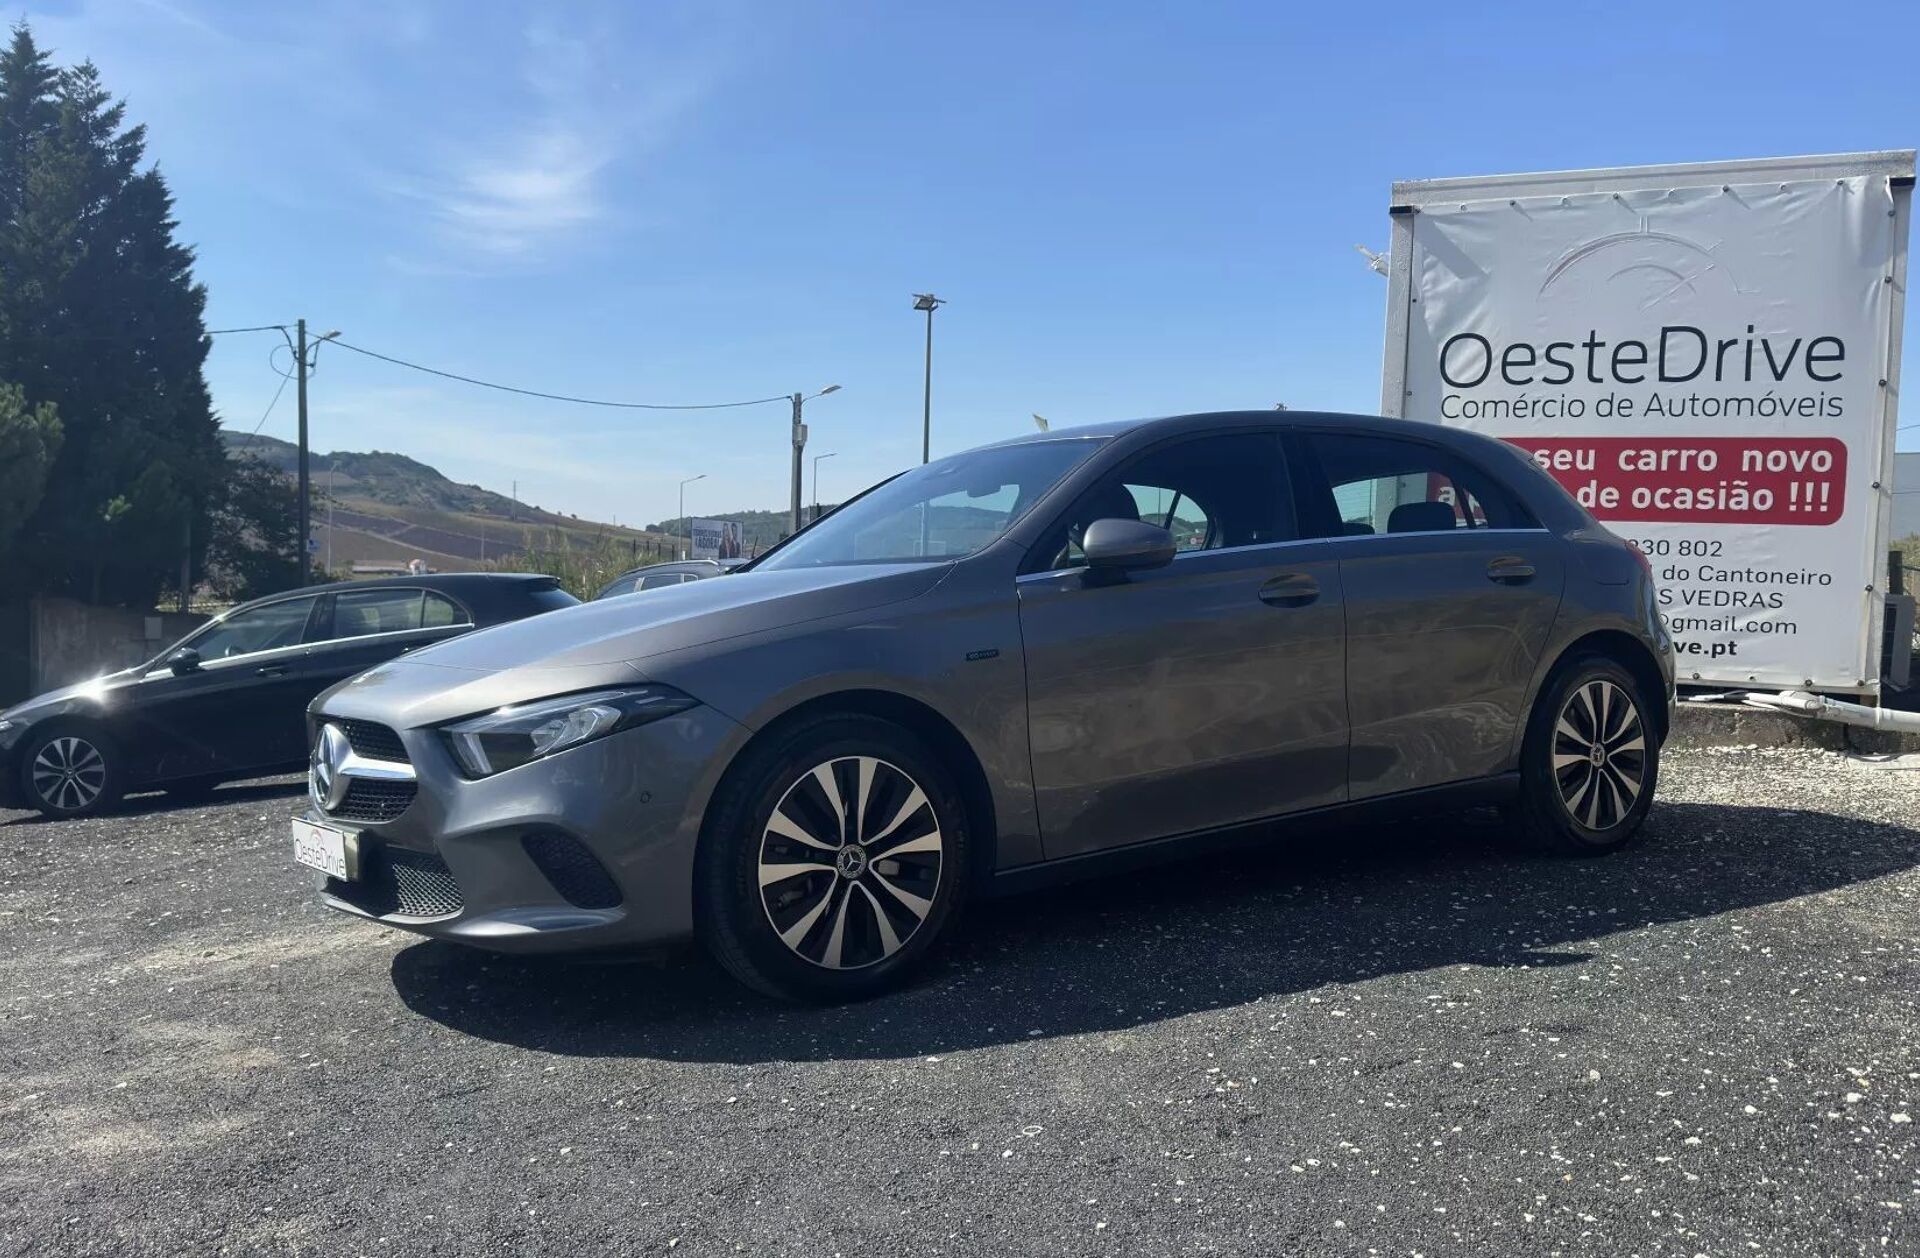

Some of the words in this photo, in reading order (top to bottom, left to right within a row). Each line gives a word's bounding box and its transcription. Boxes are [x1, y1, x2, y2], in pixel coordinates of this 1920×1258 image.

[1440, 324, 1845, 388] OesteDrive
[1441, 393, 1585, 418] Comércio
[1595, 392, 1633, 418] de
[1644, 390, 1843, 417] Automóveis
[1533, 448, 1596, 471] seu
[1618, 449, 1718, 472] carro
[1742, 449, 1833, 473] novo
[1576, 479, 1620, 509] de
[1631, 480, 1774, 511] ocasião
[1788, 481, 1830, 512] !!!
[1678, 540, 1722, 557] 802
[1662, 564, 1690, 581] do
[1698, 565, 1832, 586] Cantoneiro
[1681, 589, 1783, 609] VEDRAS
[1673, 640, 1738, 658] ve.pt
